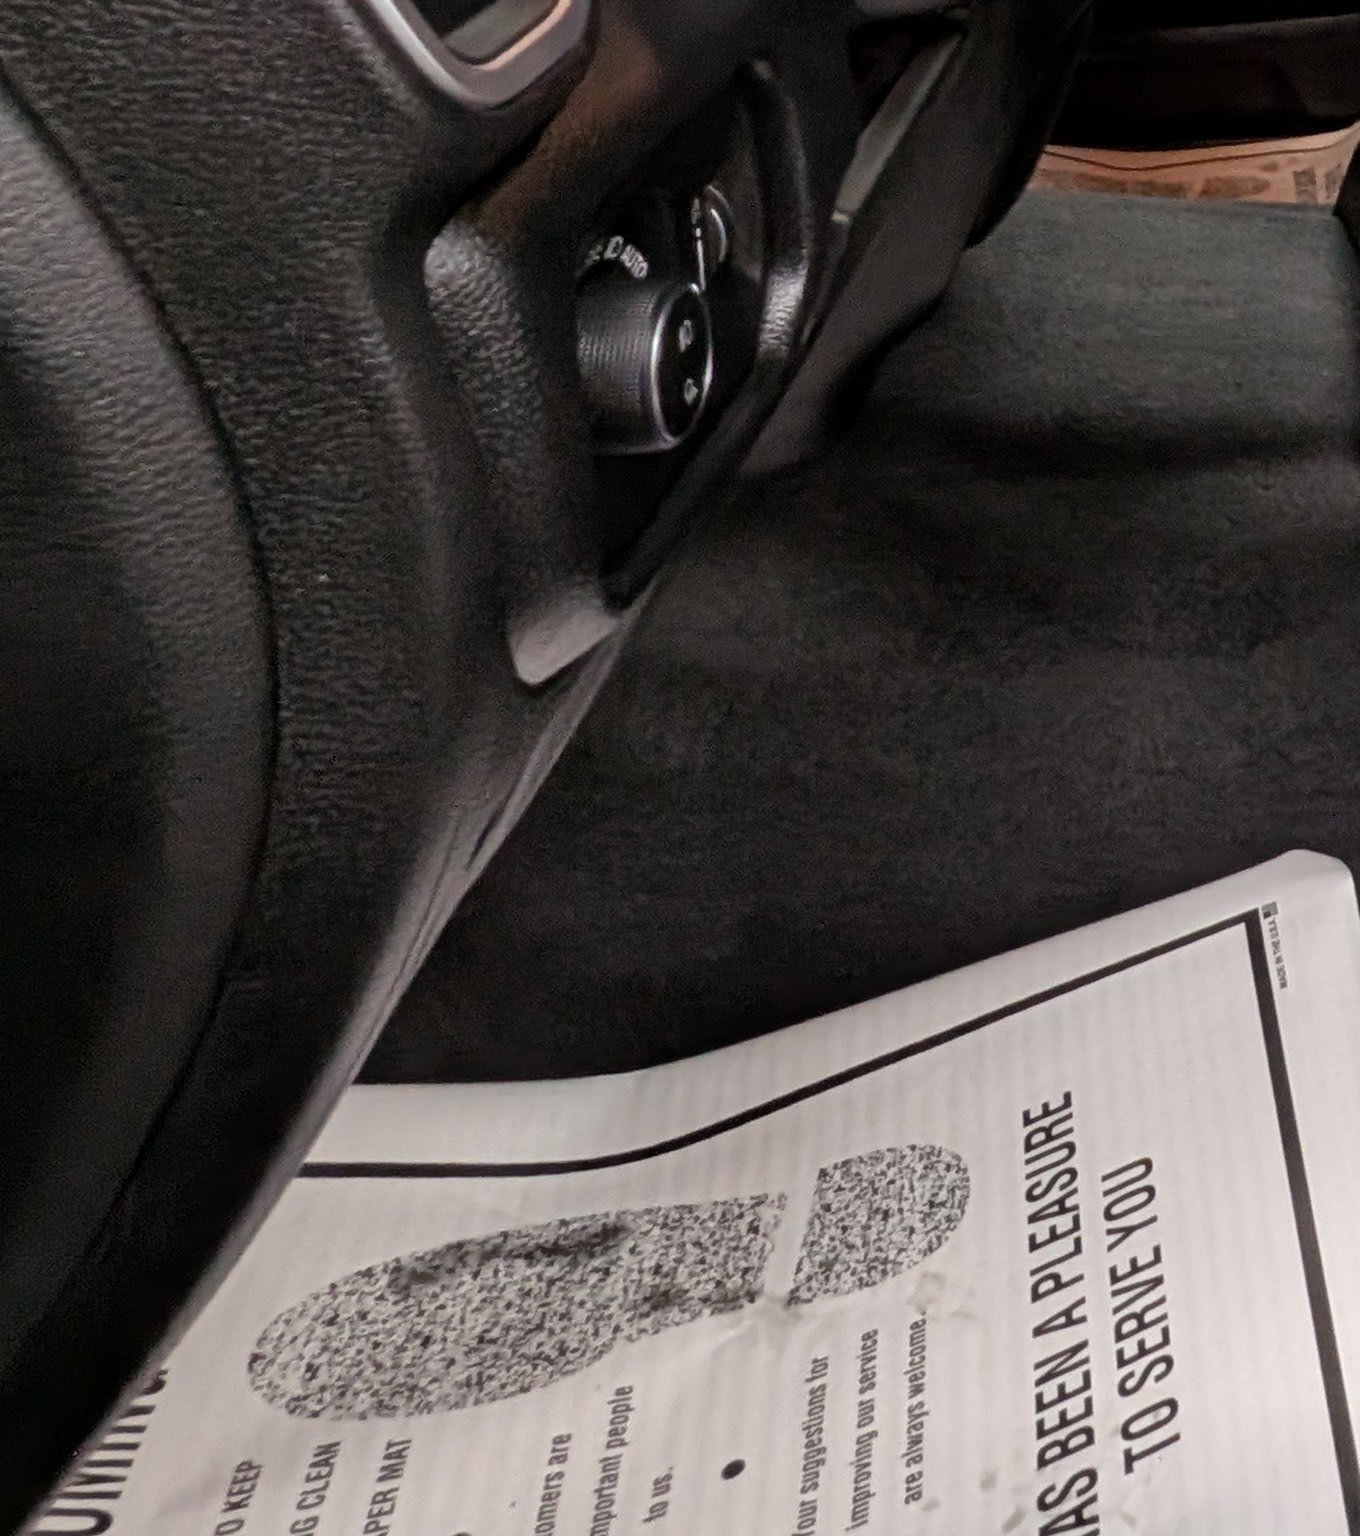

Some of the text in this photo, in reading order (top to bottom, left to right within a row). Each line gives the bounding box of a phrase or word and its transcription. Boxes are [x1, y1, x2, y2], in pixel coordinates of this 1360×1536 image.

[620, 245, 648, 279] AUTO
[1022, 1091, 1085, 1304] PLEASURE
[1031, 1296, 1088, 1339] A
[1101, 1157, 1182, 1475] TO SERVE YOU
[606, 1384, 634, 1450] people
[805, 1355, 829, 1384] for
[901, 1310, 930, 1505] are always welcome.
[1033, 1338, 1097, 1471] BEEN
[296, 1440, 342, 1510] CLEAN
[800, 1383, 828, 1495] suggestions
[845, 1328, 879, 1532] improving our service
[222, 1459, 263, 1513] KEEP
[363, 1439, 412, 1536] PER MAT
[532, 1432, 573, 1536] omers are
[644, 1465, 675, 1524] to us.
